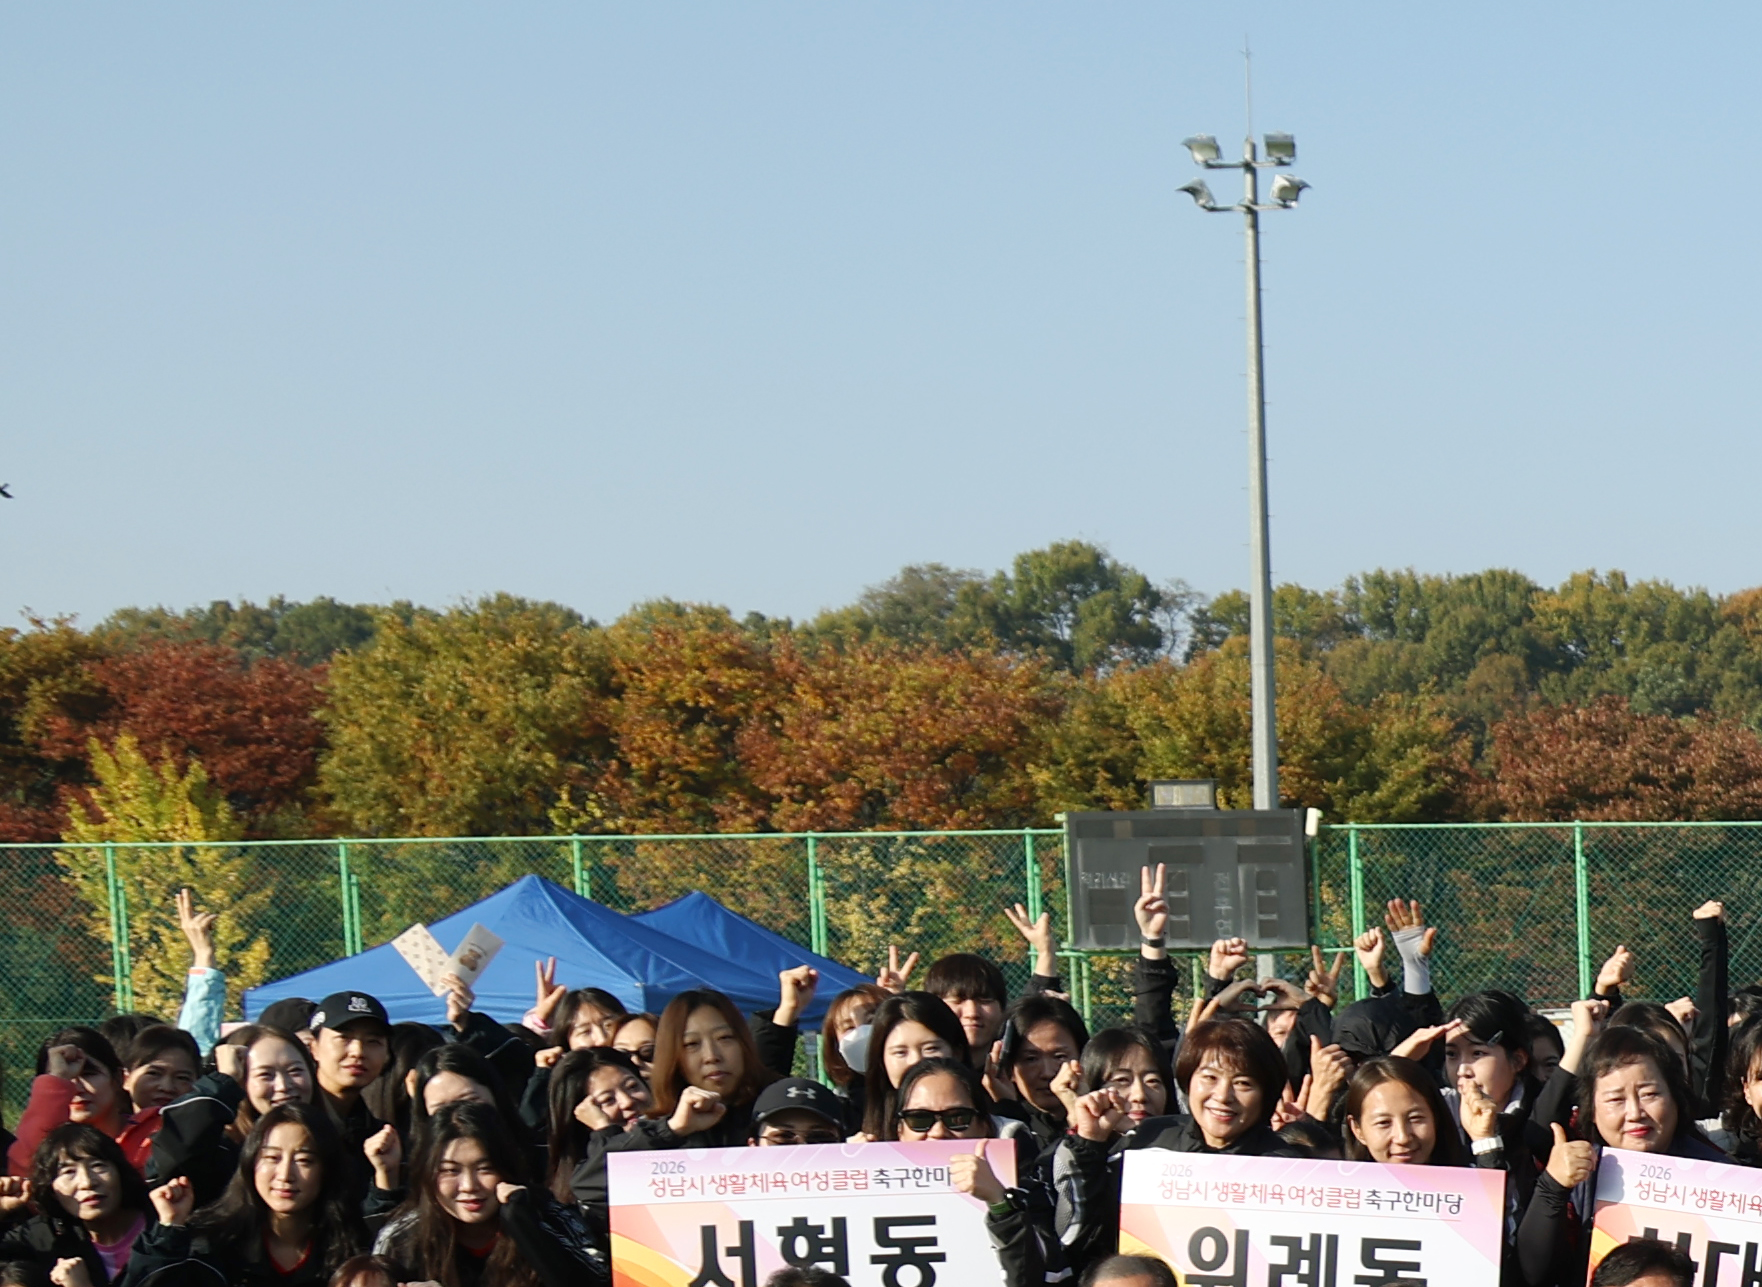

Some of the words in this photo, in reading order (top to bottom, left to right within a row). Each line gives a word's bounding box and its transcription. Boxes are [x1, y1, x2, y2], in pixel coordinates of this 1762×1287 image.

[650, 1161, 686, 1174] 2026
[1161, 1164, 1193, 1177] 2026
[1639, 1163, 1671, 1180] 2026
[648, 1176, 704, 1198] 성남시
[709, 1172, 789, 1195] 생활체육
[790, 1169, 868, 1192] 여성클럽
[872, 1166, 951, 1190] 축구한마
[1634, 1180, 1688, 1203] 성남시
[1158, 1179, 1210, 1200] 성남시
[1212, 1181, 1285, 1205] 생활체육
[1287, 1186, 1361, 1209] 여성클럽
[1365, 1190, 1463, 1215] 축구한마당
